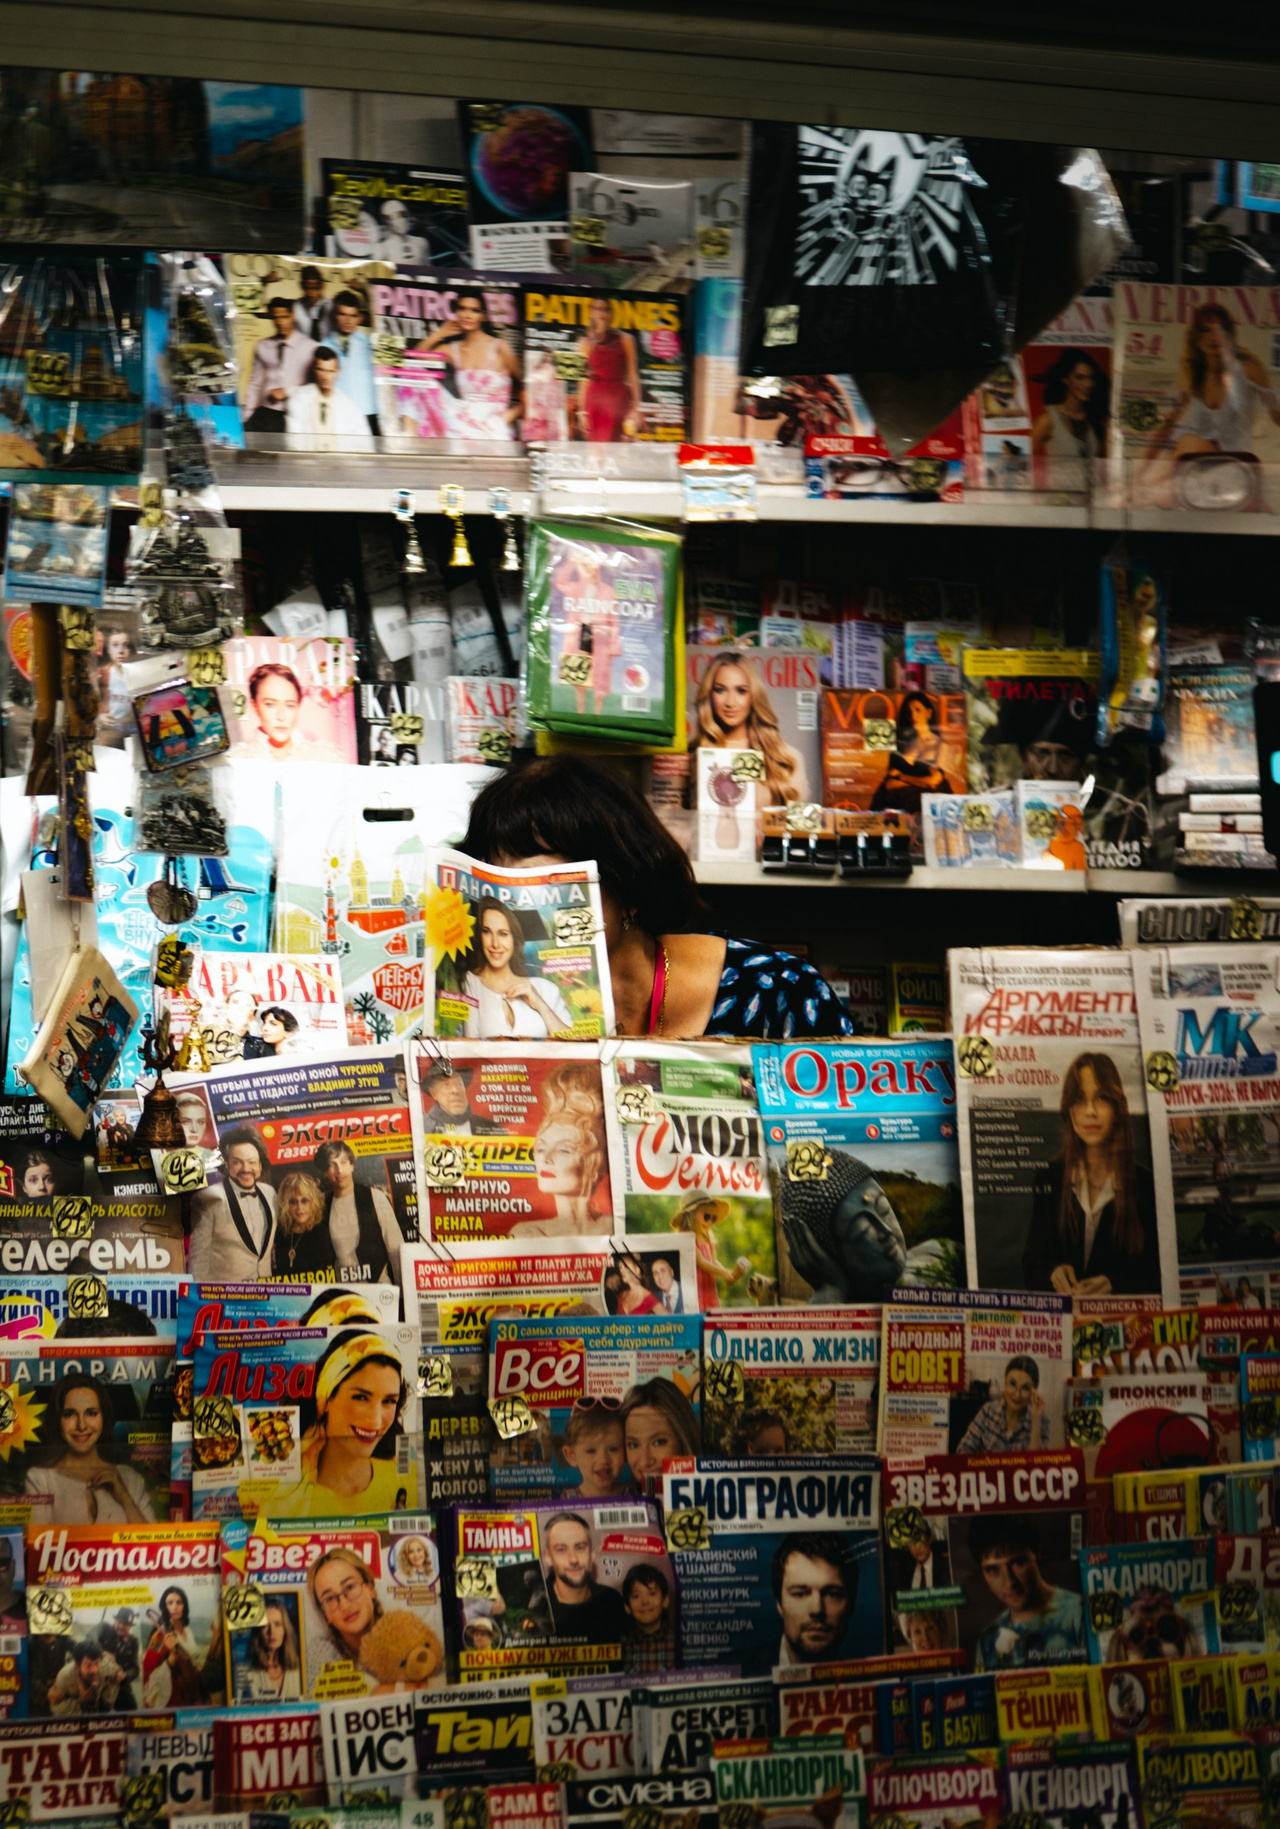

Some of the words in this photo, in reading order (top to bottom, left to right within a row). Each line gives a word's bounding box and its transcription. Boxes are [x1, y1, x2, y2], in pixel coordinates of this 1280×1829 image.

[372, 285, 519, 324] PATROES
[613, 579, 658, 602] EVA
[562, 596, 658, 620] RAINCOAT
[826, 692, 963, 731] VOE
[440, 870, 587, 908] ПАНОРАМА
[177, 957, 339, 1005] АРАВАН
[1177, 1006, 1265, 1058] МК
[210, 1077, 251, 1095] ПЕРВЫМ
[252, 1070, 307, 1091] МУЖЧИНОЙ
[308, 1065, 340, 1084] ЮНОЙ
[339, 1061, 385, 1080] ЧУРСИНОЙ
[222, 1091, 246, 1105] СТАЛ
[247, 1090, 259, 1103] ЕЕ
[259, 1085, 300, 1102] ПЕДАГОГ
[307, 1078, 356, 1095] ВЛАДИМИР
[356, 1075, 380, 1091] ЭТУШ
[279, 1112, 403, 1146] ЭКСПРЕСС
[668, 1112, 763, 1159] МОЯ
[113, 1182, 158, 1198] КЭМЕРОН
[108, 1203, 167, 1218] КРАСОТЫ
[445, 1197, 533, 1214] МАНЕРНОСТЬ
[434, 1215, 484, 1232] РЕНАТА
[340, 1265, 372, 1282] БЫЛ
[453, 1259, 518, 1275] ПРИГОЖИНА
[520, 1260, 533, 1272] НЕ
[534, 1258, 572, 1271] ПЛАТЯТ
[418, 1277, 432, 1289] ЗА
[433, 1274, 497, 1288] ПОГИБШЕГО
[499, 1274, 512, 1286] НА
[513, 1272, 559, 1285] УКРАИНЕ
[561, 1271, 594, 1284] МУЖА
[497, 1323, 518, 1342] 30
[520, 1324, 553, 1338] самых
[555, 1324, 601, 1337] опасных
[603, 1323, 635, 1339] афер:
[637, 1324, 651, 1335] не
[653, 1322, 684, 1337] дайте
[588, 1337, 614, 1349] себя
[615, 1336, 675, 1351] одурачить!
[890, 1328, 962, 1351] НАРОДНЫЙ
[710, 1328, 805, 1364] Однако,
[970, 1339, 997, 1353] ДЛЯ
[889, 1349, 963, 1386] СОВЕТ
[1109, 1385, 1198, 1401] ЯПОНСКИЕ
[669, 1473, 873, 1521] БИОГРАФИЯ
[890, 1464, 1008, 1512] ЗВЁЗДЫ
[1012, 1466, 1080, 1502] СССР
[464, 1525, 533, 1549] ТАЙНЫ
[246, 1538, 373, 1571] Звезы
[674, 1546, 758, 1564] СТРАВИНСКИЙ
[685, 1563, 737, 1575] ШАНЕЛЬ
[720, 1587, 751, 1600] РУРК
[465, 1650, 524, 1667] ПОЧЕМУ
[527, 1648, 546, 1664] ОН
[549, 1647, 580, 1664] УЖЕ
[581, 1646, 594, 1661] 11
[595, 1645, 621, 1661] ЛЕТ
[421, 1687, 497, 1704] ОСТОРОЖНО:
[872, 1767, 999, 1807] КЛЮЧВОРД
